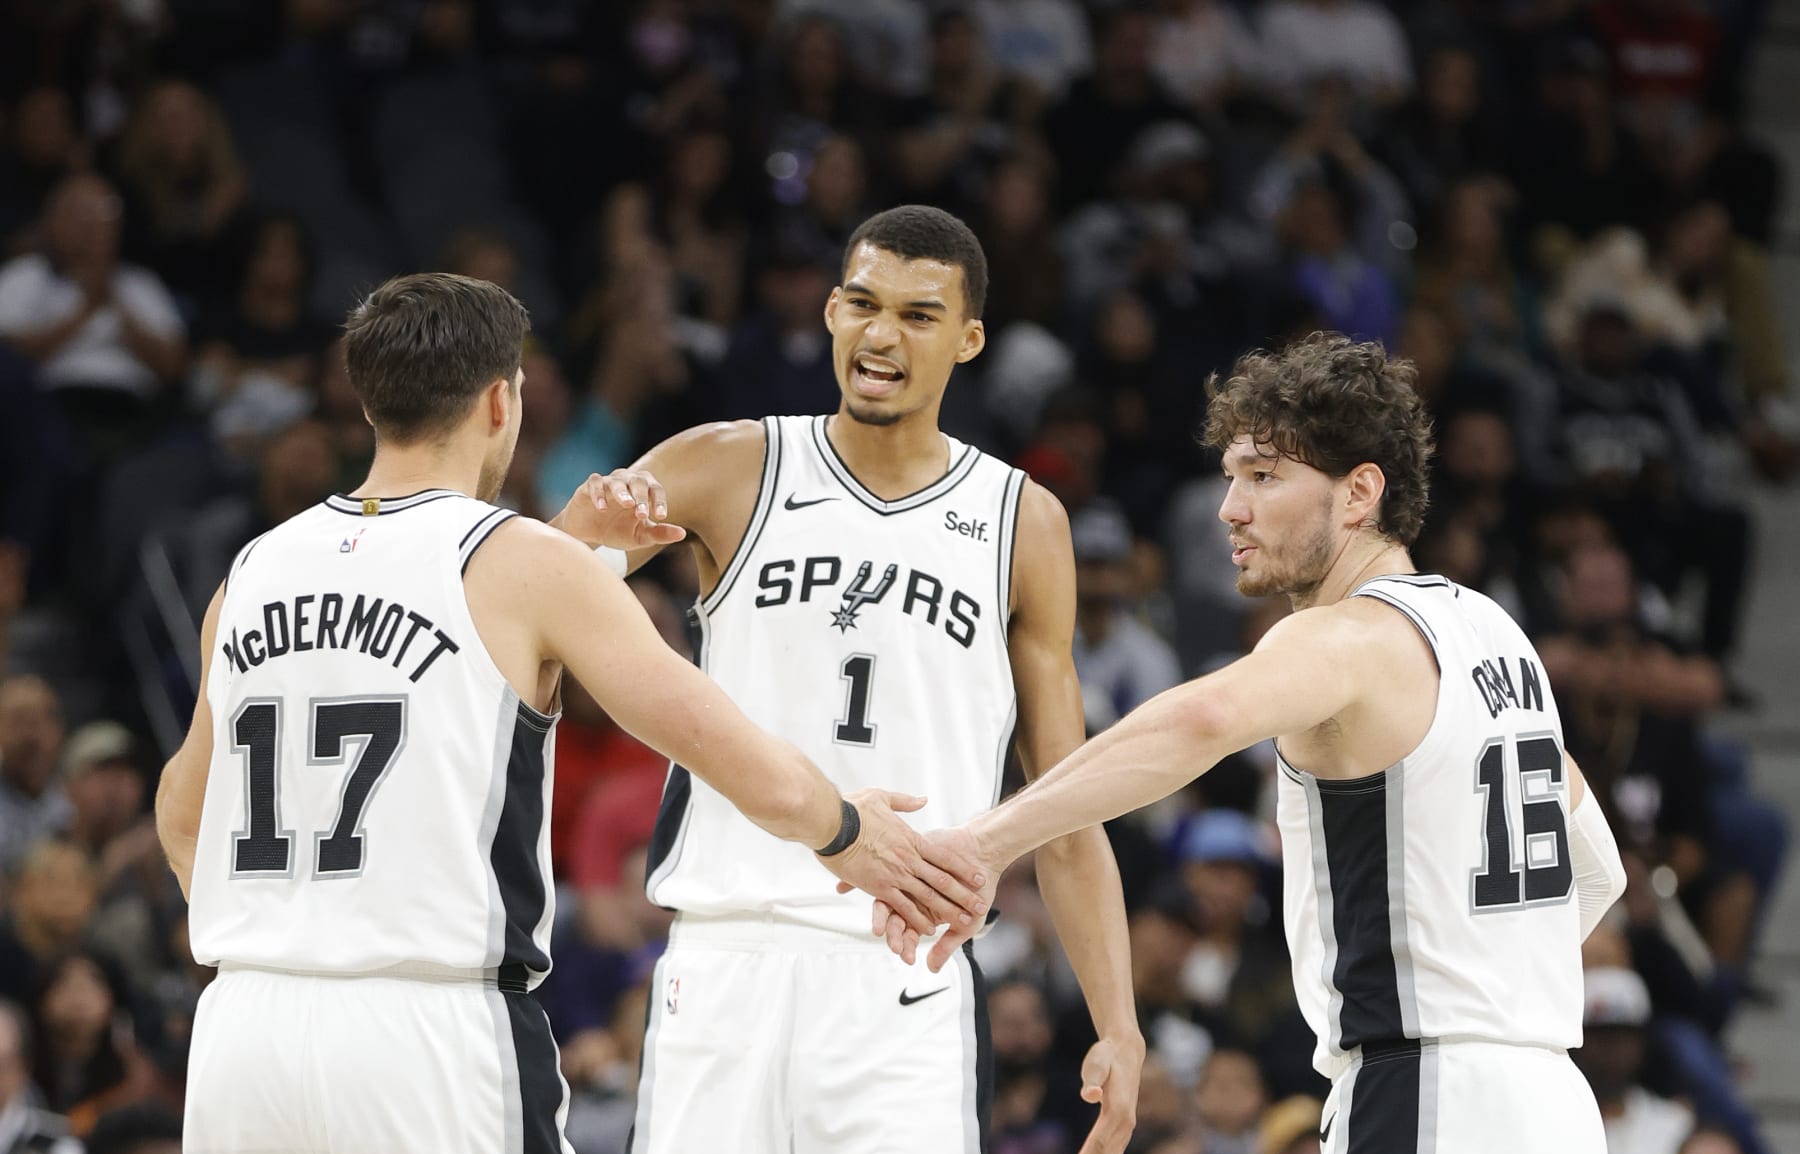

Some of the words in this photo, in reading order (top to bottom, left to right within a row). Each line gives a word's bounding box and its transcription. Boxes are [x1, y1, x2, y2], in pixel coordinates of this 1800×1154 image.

[944, 511, 988, 542] Self.
[755, 556, 980, 648] SPURS
[832, 652, 877, 748] 1
[228, 693, 408, 880] 17
[1469, 730, 1575, 916] 16
